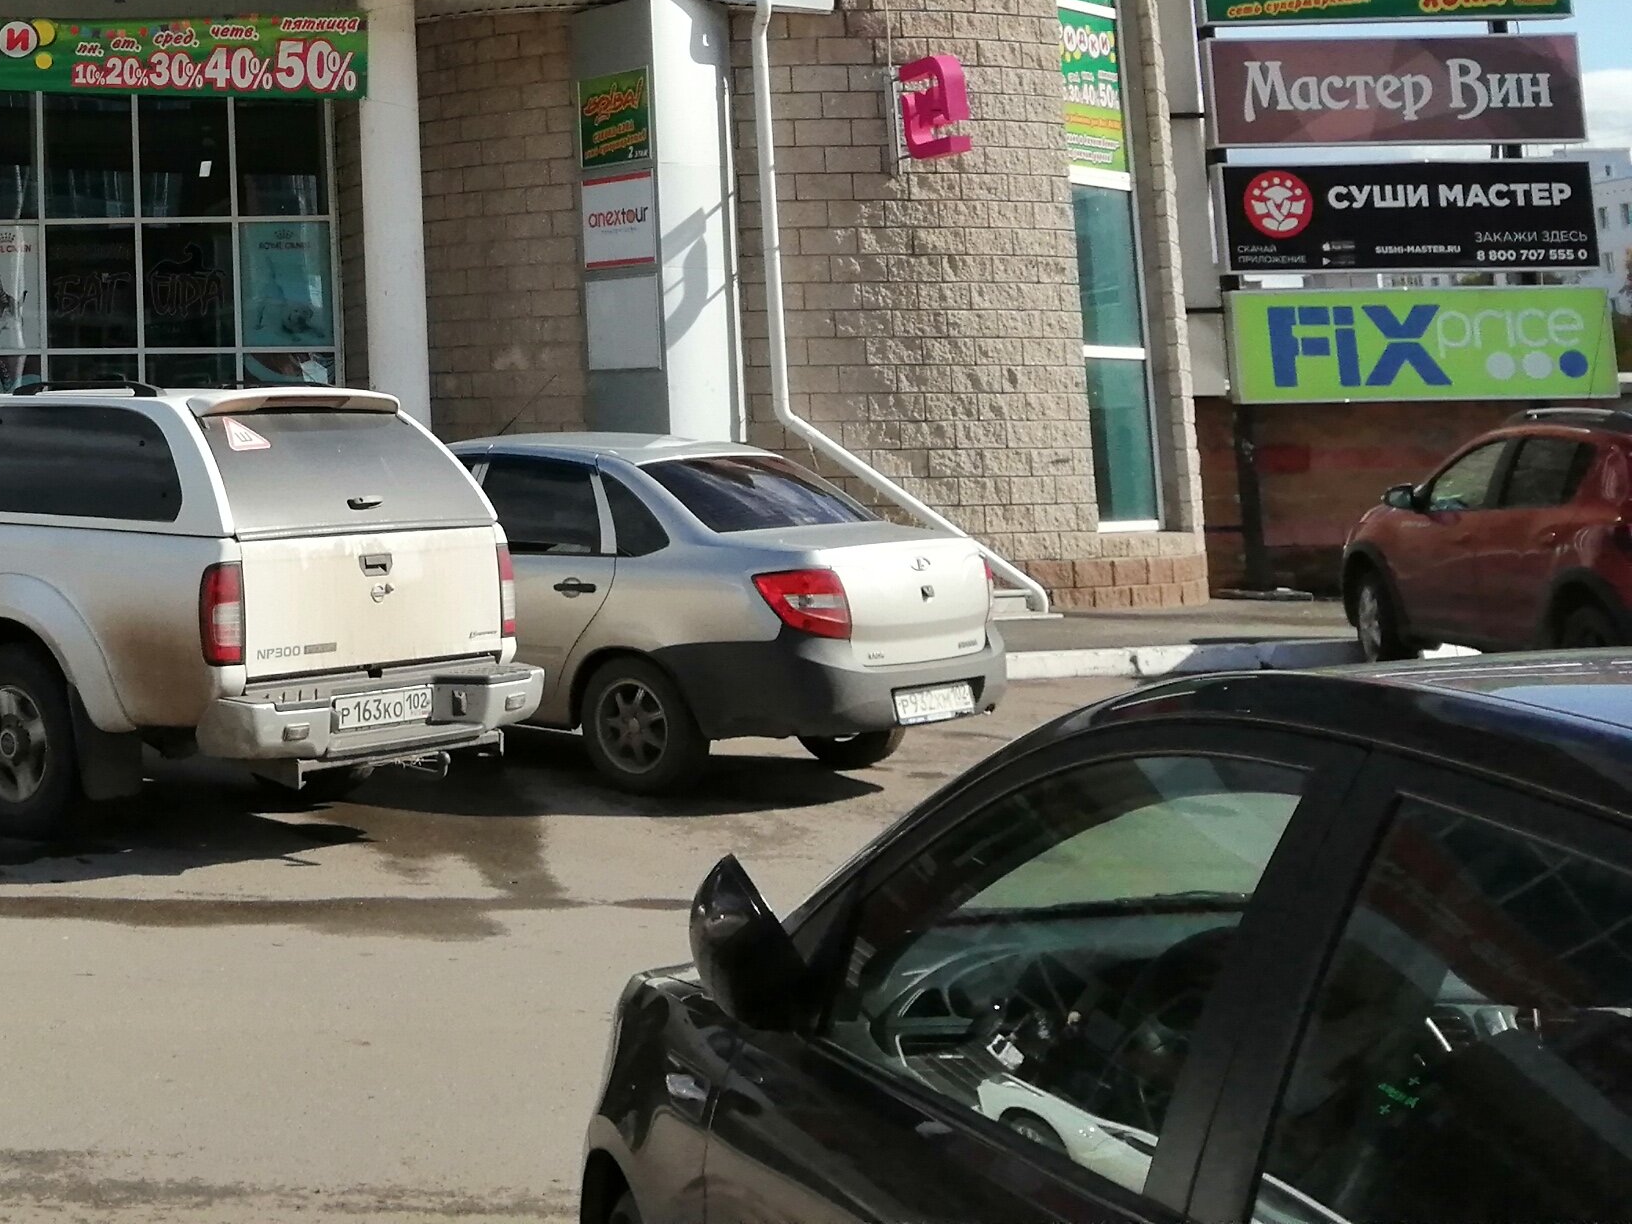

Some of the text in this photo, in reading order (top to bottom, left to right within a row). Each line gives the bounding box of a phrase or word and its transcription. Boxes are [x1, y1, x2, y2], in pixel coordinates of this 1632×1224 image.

[209, 25, 260, 42] четв.
[279, 15, 360, 34] пятница
[152, 28, 200, 48] сред.
[77, 41, 105, 57] пн.
[74, 63, 106, 86] 10%
[105, 57, 149, 87] 20%
[149, 52, 204, 88] 30%
[204, 47, 273, 90] 40%
[276, 40, 357, 91] 50%
[1244, 58, 1554, 122] Мастер Вин
[1326, 182, 1572, 211] СУШИ МАСТЕР
[1474, 230, 1589, 244] ЗАКАЖИ ЗДЕСЬ
[1375, 244, 1462, 255] SUSHI-MASTER.RU
[1476, 249, 1588, 262] 8 800 707 555 0
[1436, 308, 1584, 358] price
[256, 644, 302, 661] NP300
[405, 690, 428, 710] 102
